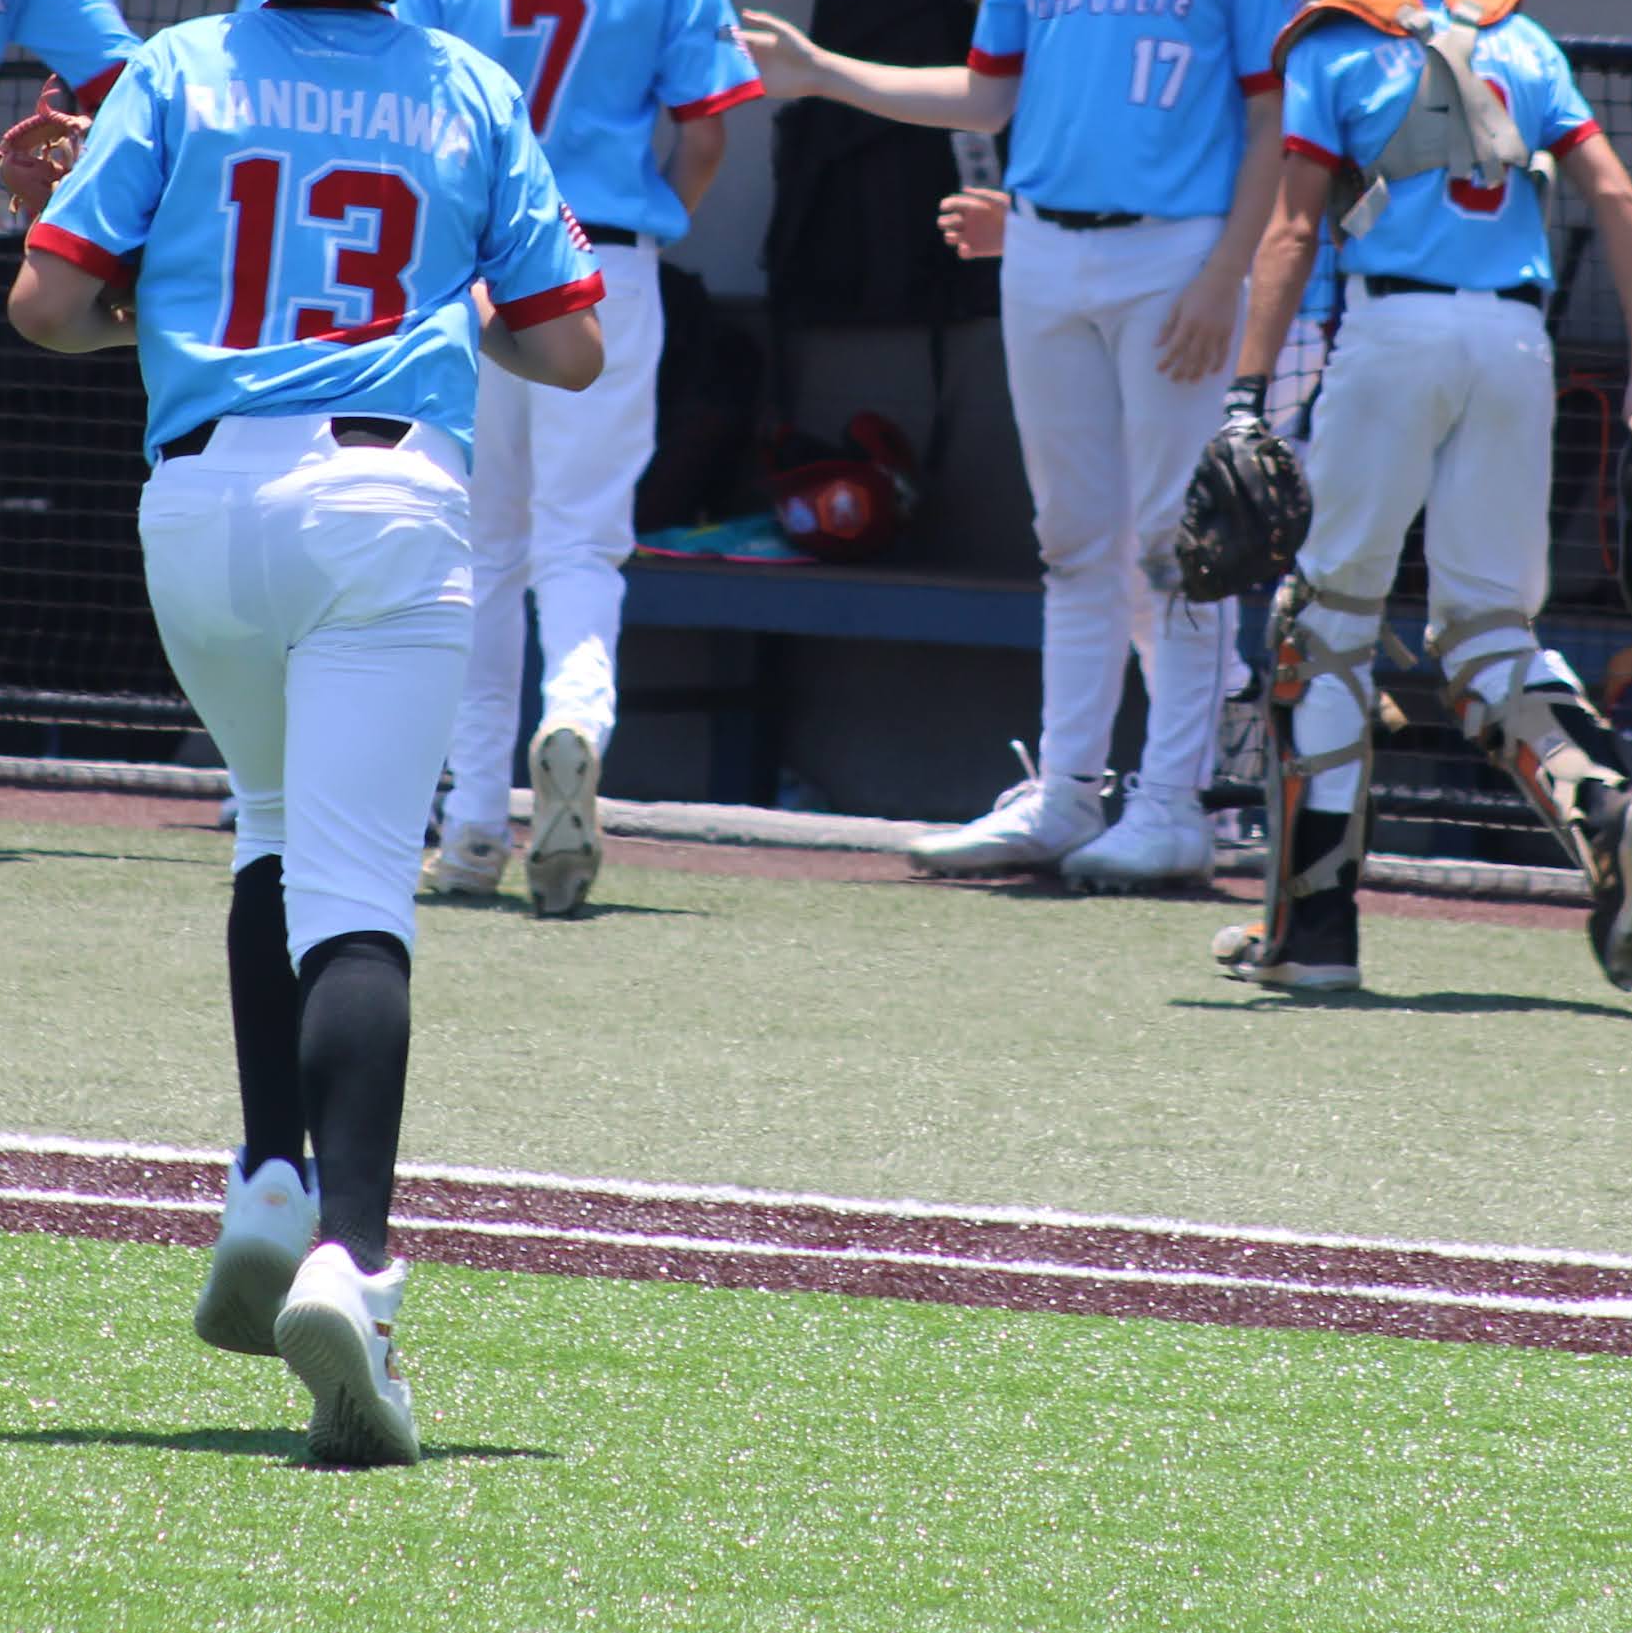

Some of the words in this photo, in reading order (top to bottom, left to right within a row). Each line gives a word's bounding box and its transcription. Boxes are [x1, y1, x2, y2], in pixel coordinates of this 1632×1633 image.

[1128, 36, 1193, 111] 17
[184, 77, 472, 168] RANDHAWA
[211, 147, 429, 352] 13
